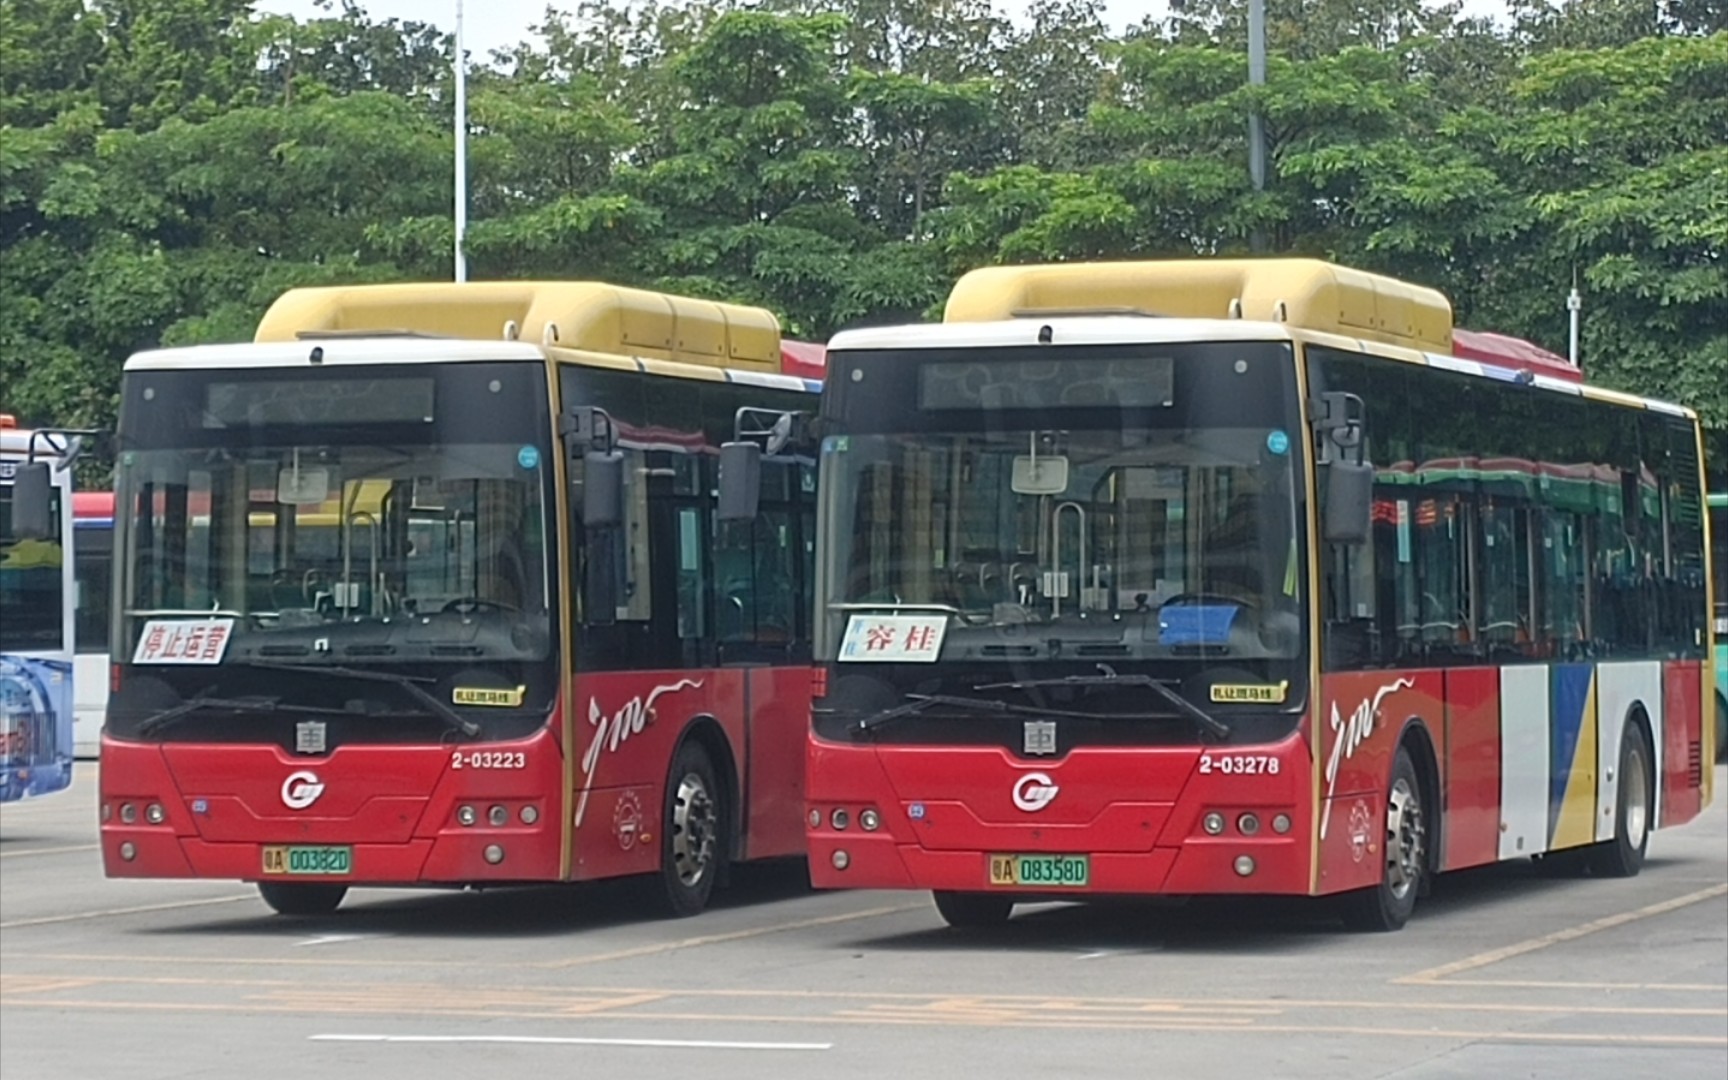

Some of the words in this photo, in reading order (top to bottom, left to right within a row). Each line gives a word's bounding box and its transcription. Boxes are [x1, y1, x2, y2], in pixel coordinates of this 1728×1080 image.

[141, 625, 226, 660] 停止运营
[866, 624, 936, 652] 容桂
[452, 752, 525, 769] 2-03223
[1199, 756, 1279, 774] 2-03278
